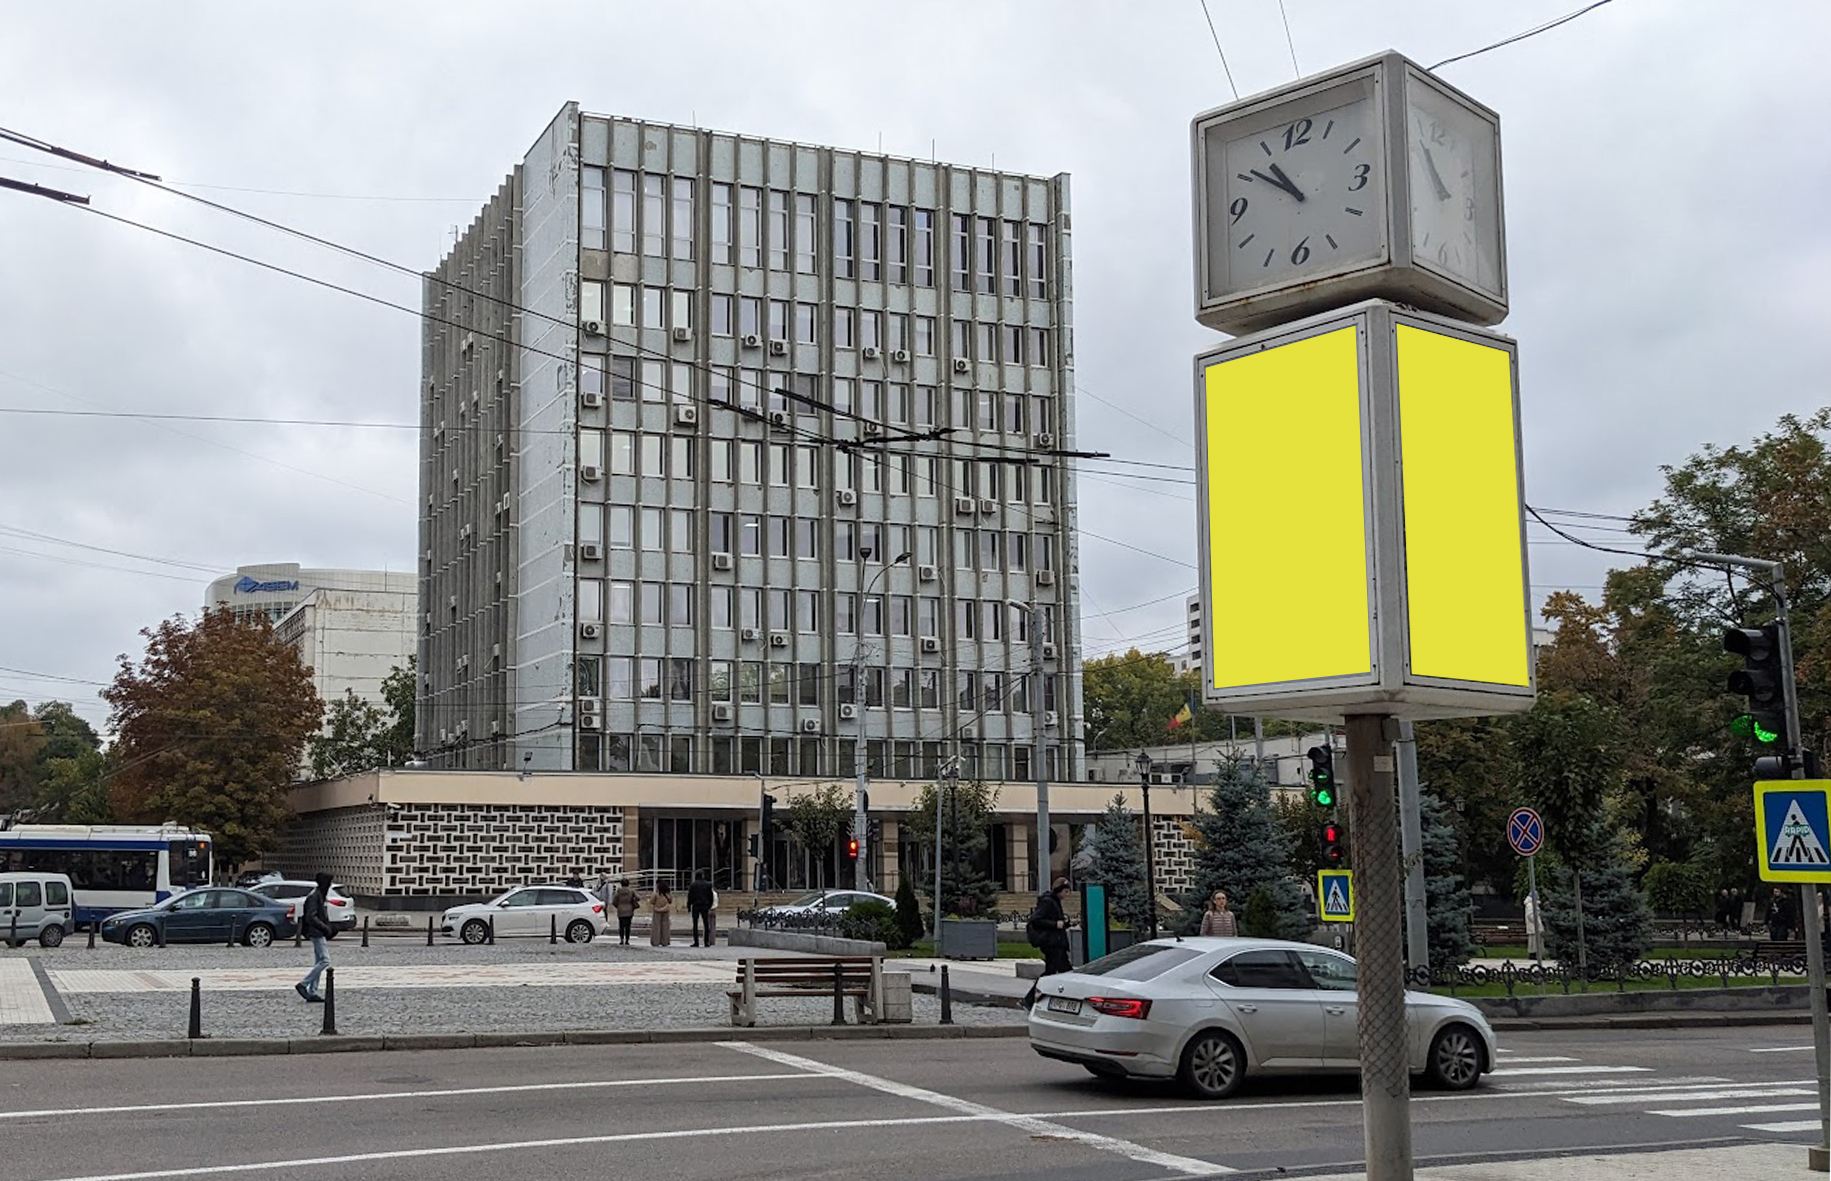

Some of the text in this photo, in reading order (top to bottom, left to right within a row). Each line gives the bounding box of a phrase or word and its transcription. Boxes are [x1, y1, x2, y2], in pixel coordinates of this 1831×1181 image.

[1281, 119, 1313, 152] 12
[1348, 163, 1371, 192] 3
[1230, 197, 1249, 226] 9
[1291, 235, 1311, 266] 6
[1438, 241, 1448, 266] 6
